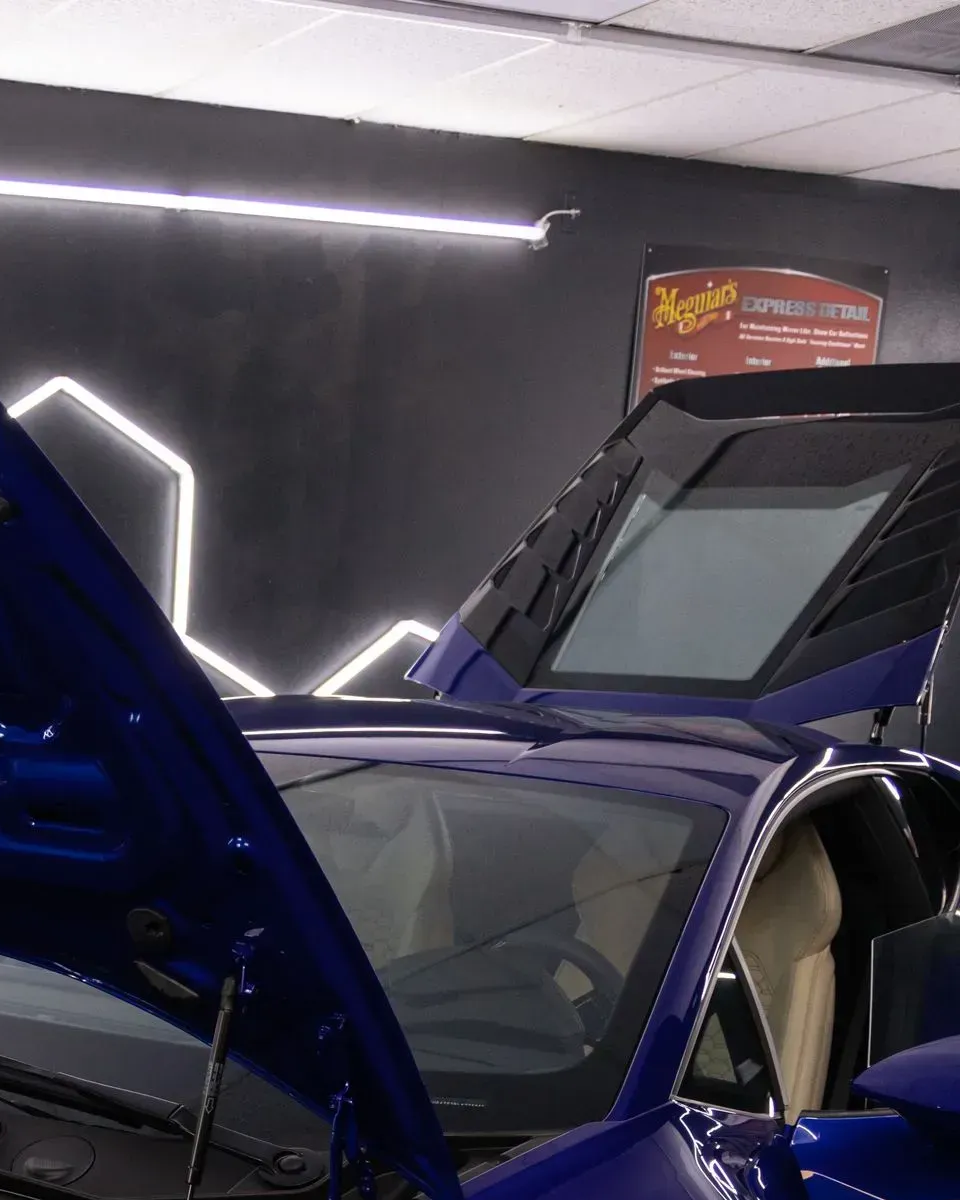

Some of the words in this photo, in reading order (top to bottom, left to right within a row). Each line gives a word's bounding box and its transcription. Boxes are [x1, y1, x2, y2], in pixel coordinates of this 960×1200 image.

[652, 279, 738, 334] Meguiar's
[741, 296, 816, 317] EXPRESS
[819, 302, 871, 321] DETAIL
